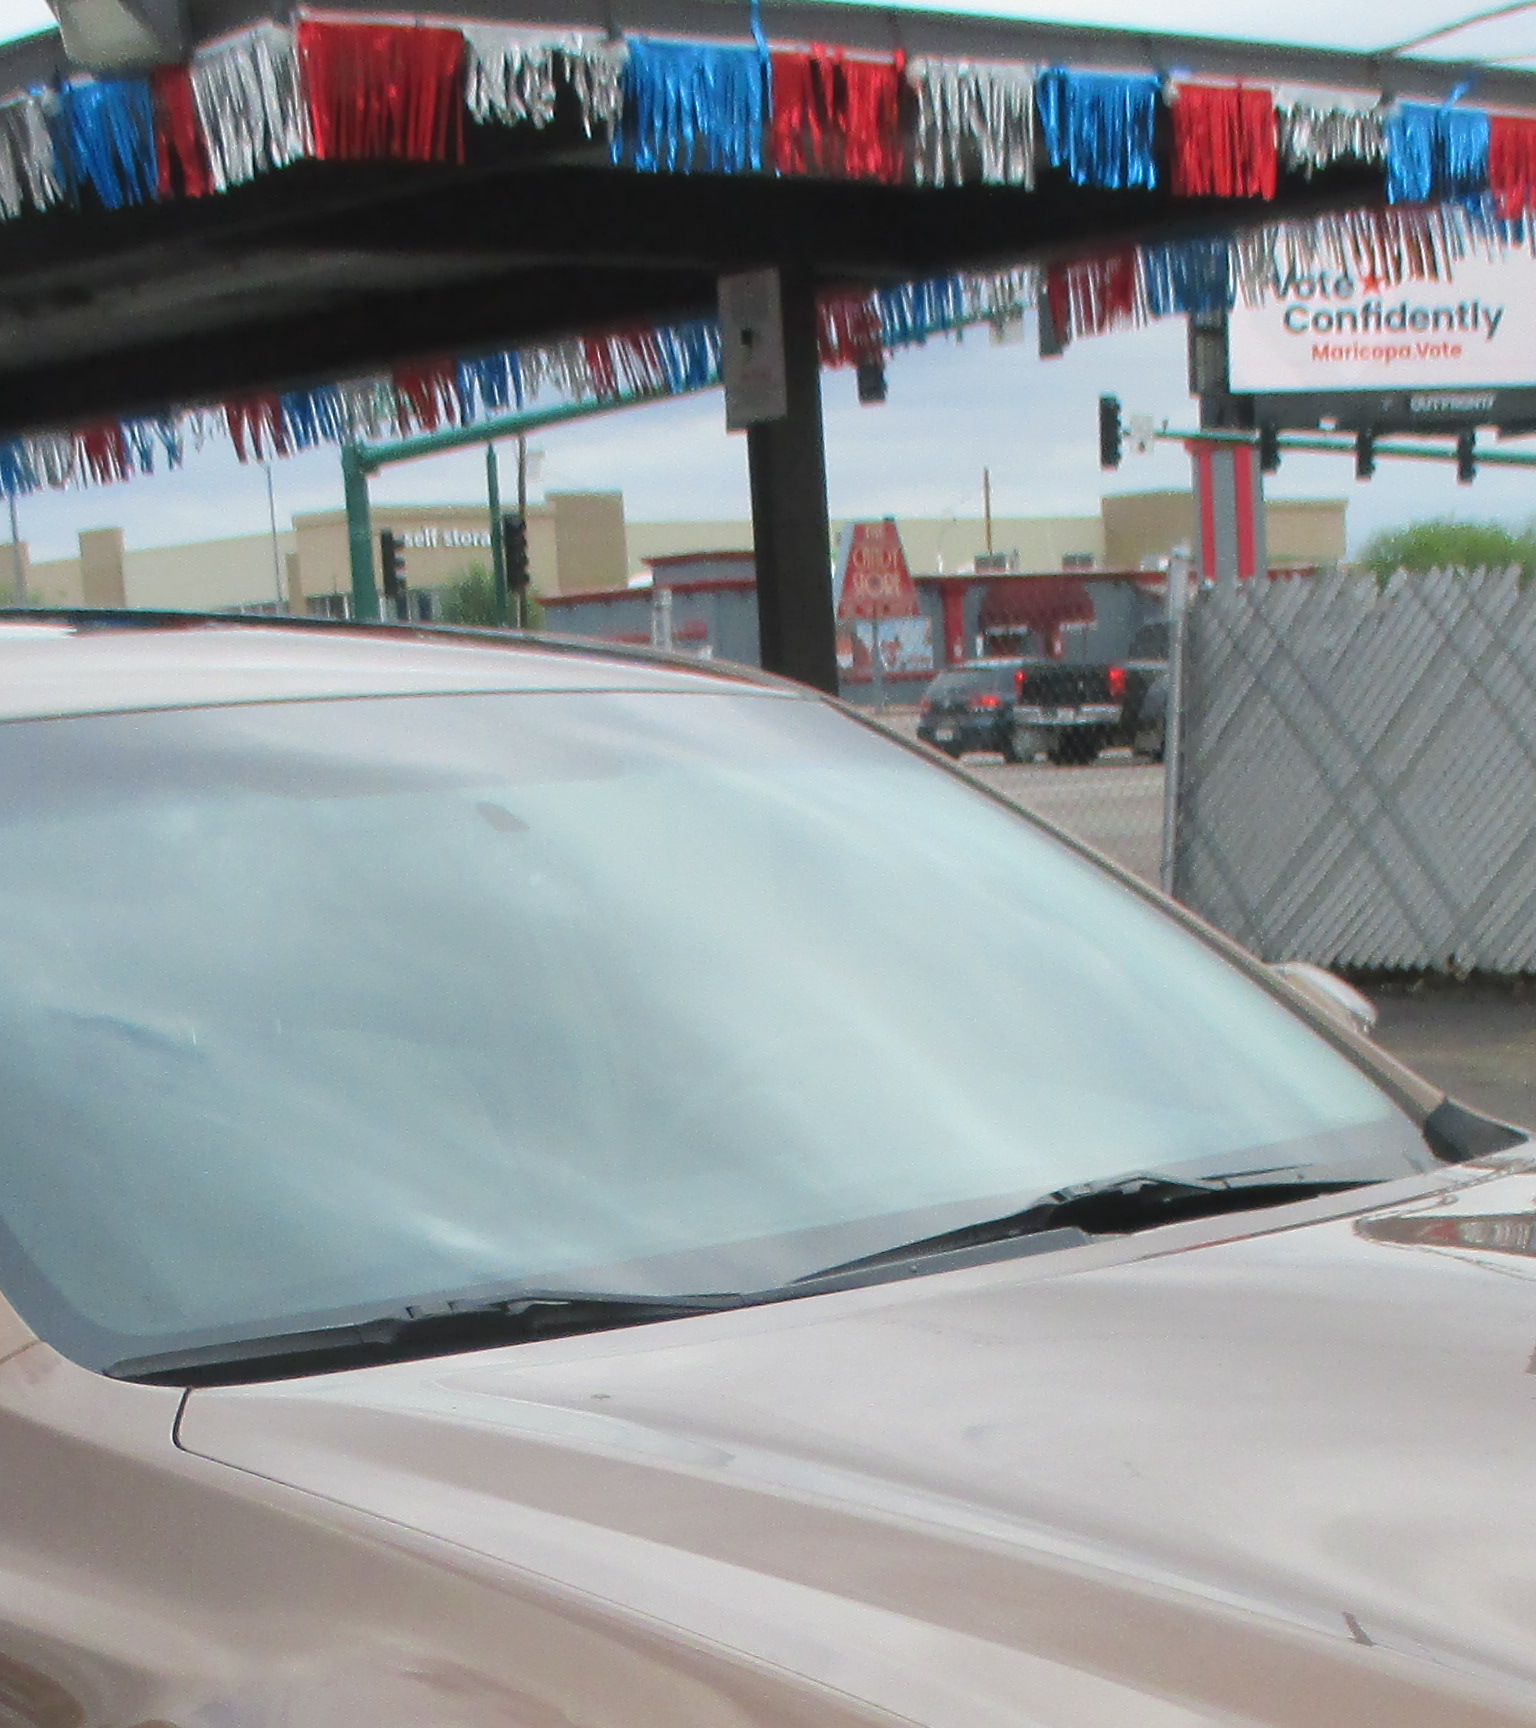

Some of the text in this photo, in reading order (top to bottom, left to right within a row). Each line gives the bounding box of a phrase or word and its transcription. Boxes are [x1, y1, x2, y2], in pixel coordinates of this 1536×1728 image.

[1282, 300, 1505, 341] Confidently
[404, 526, 492, 548] self stora
